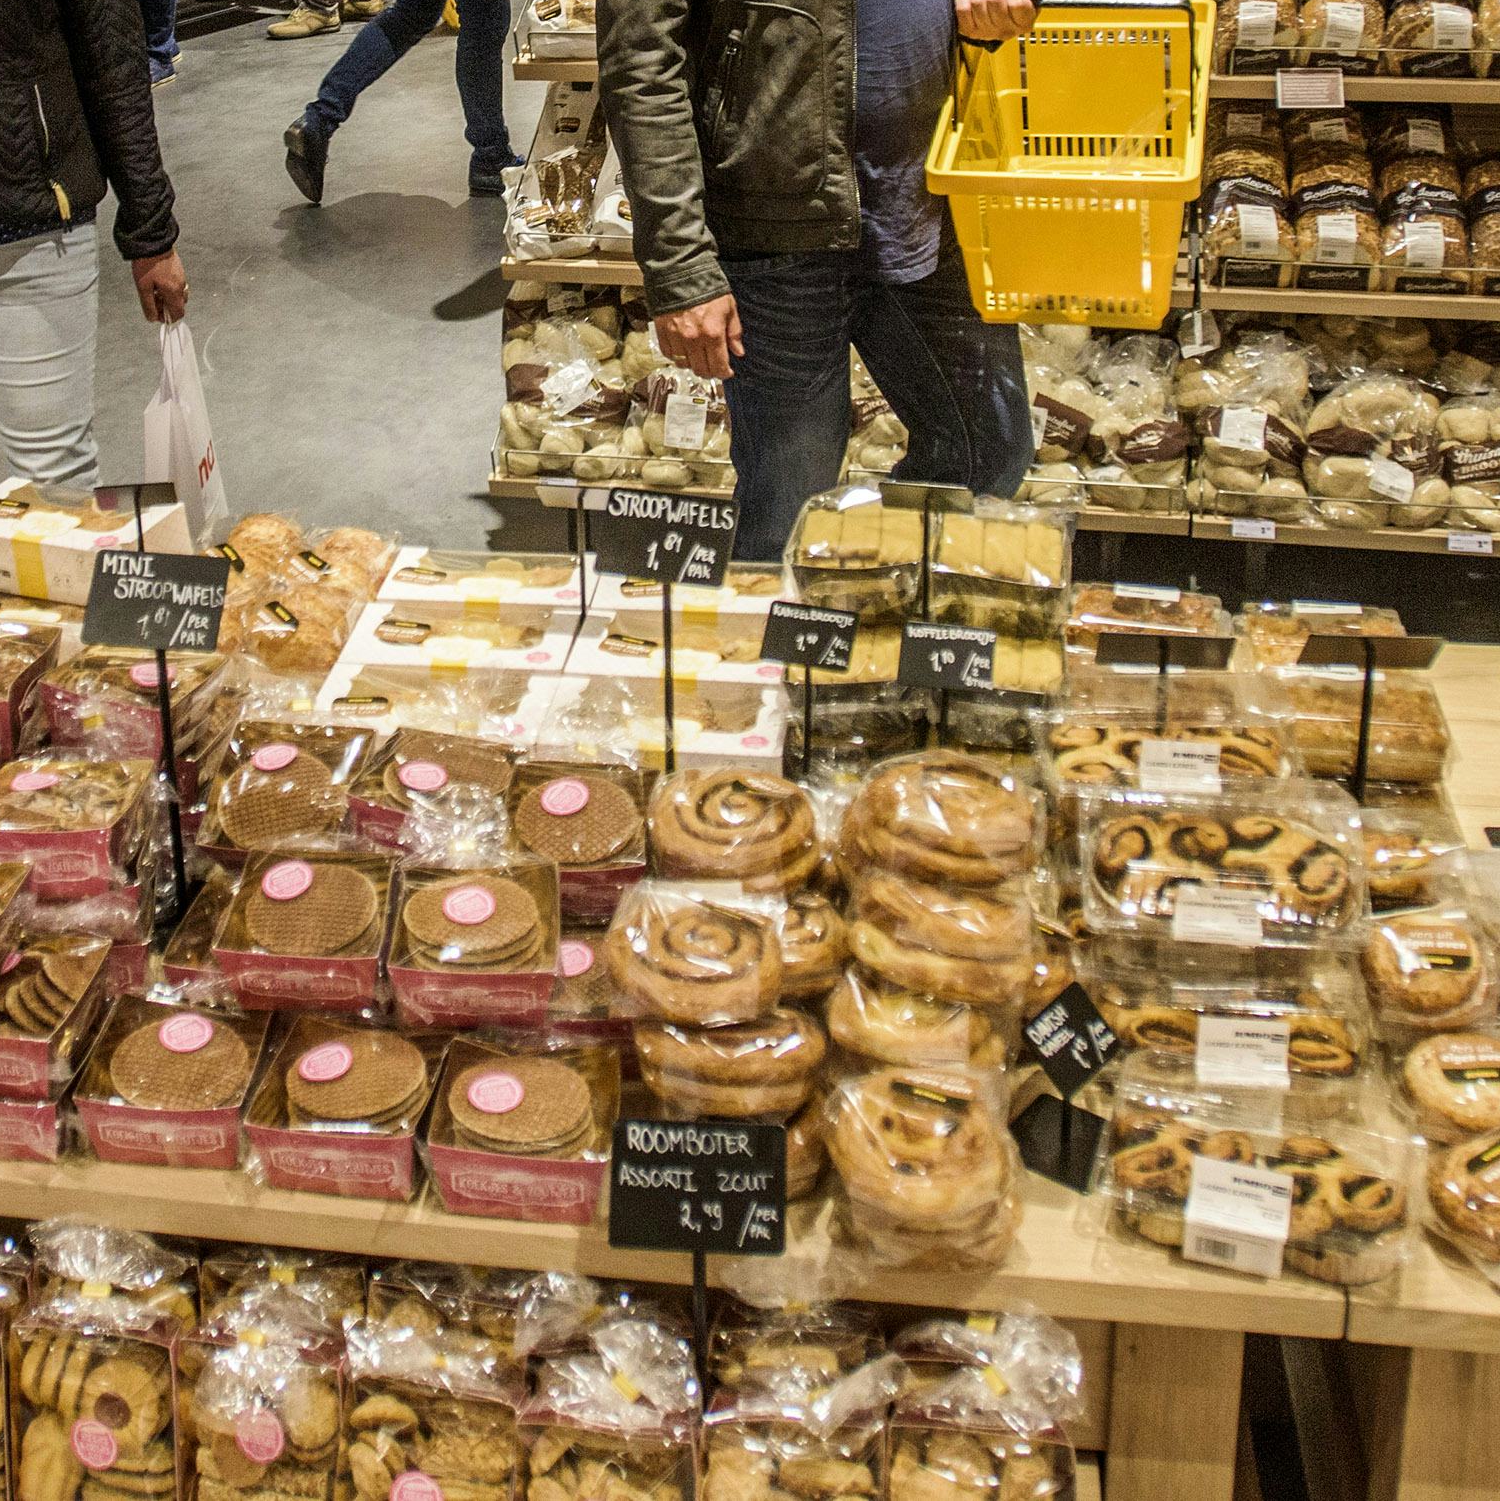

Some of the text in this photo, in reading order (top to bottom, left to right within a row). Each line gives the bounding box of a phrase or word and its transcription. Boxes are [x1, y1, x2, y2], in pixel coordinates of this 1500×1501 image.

[608, 491, 735, 530] STROOPWAFELS
[102, 553, 156, 578] MINI
[694, 548, 717, 565] PER
[687, 563, 712, 579] PAK
[113, 578, 225, 609] STROOPWAFELS
[187, 614, 210, 630] PER
[180, 631, 207, 646] PAK
[626, 1123, 754, 1158] ROOMBOTER
[618, 1162, 774, 1193] ASSORTI ZOUT
[754, 1205, 779, 1224] PER
[749, 1223, 772, 1241] PAK
